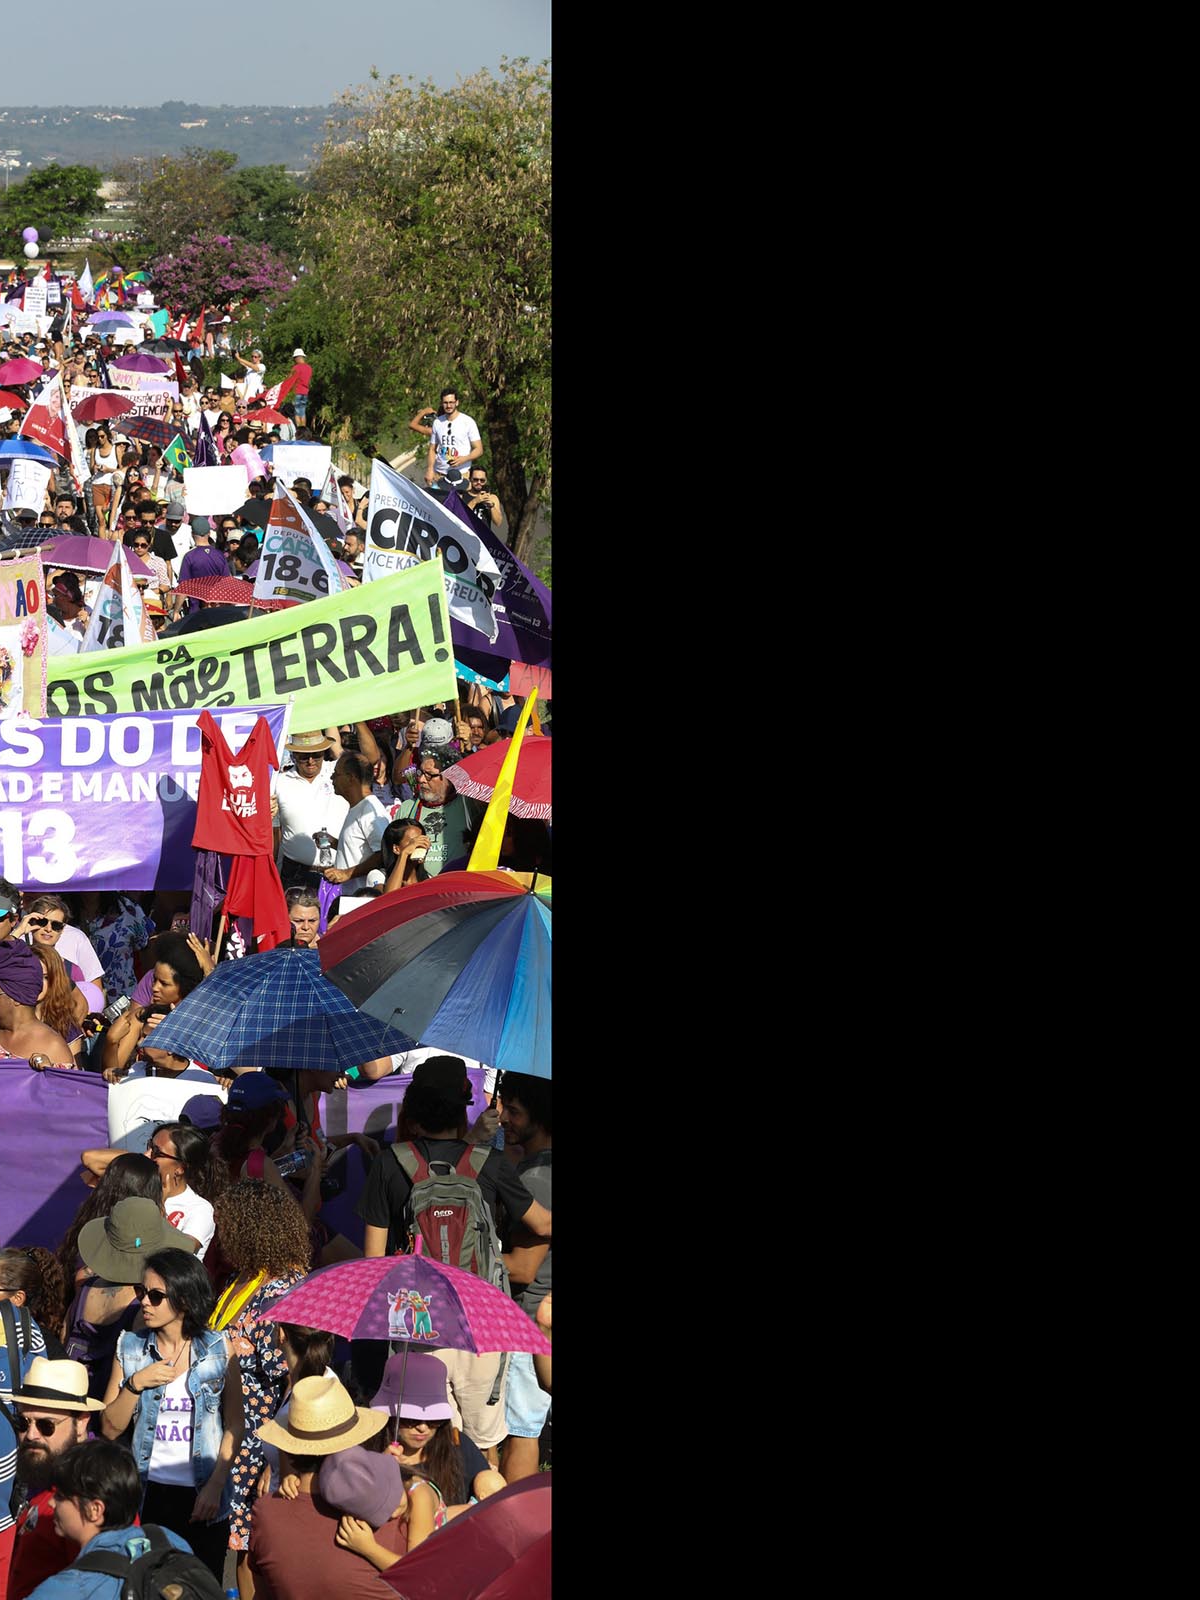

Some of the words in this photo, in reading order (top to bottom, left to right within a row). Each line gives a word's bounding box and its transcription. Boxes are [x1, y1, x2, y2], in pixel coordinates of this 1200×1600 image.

[442, 434, 456, 446] ELE
[374, 493, 434, 522] PRESIDENTE
[370, 507, 470, 574] CIRO
[367, 551, 395, 569] VICE
[230, 593, 450, 700] TERRA!
[61, 716, 154, 768] DO
[41, 772, 62, 803] E
[155, 1420, 194, 1442] NÃO
